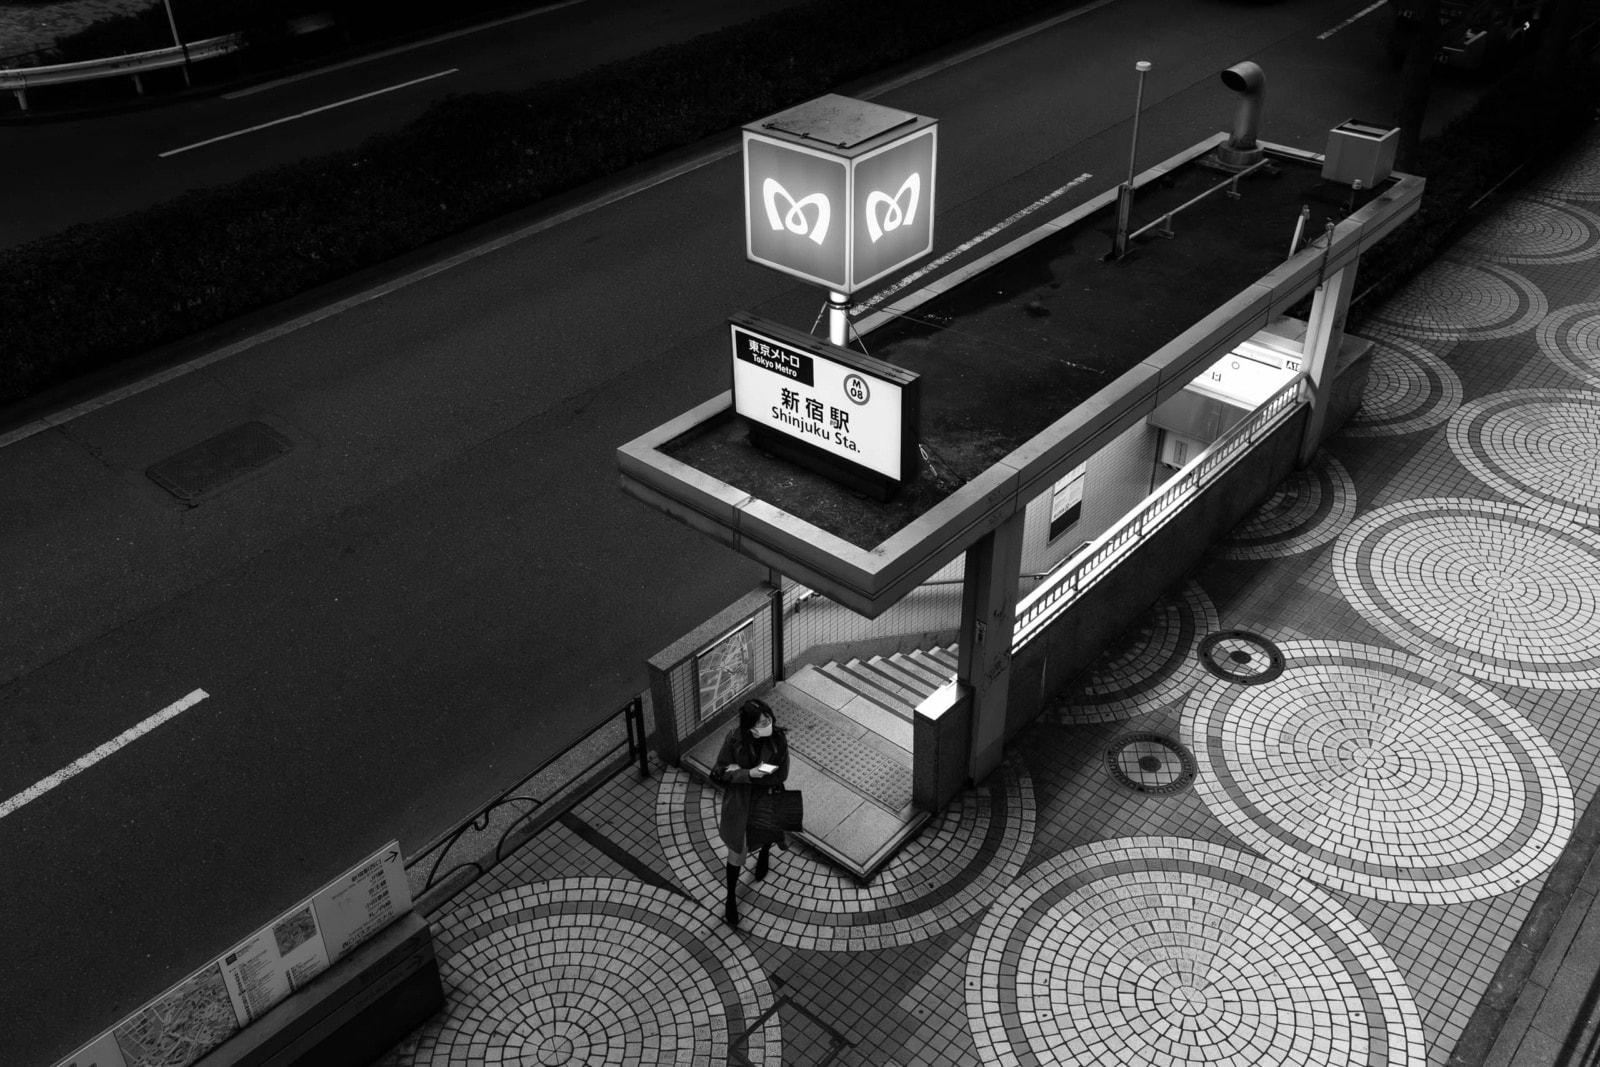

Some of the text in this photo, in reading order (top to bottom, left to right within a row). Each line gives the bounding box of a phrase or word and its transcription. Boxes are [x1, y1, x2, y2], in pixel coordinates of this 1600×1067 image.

[748, 339, 800, 369] 東京メトロ
[752, 353, 797, 377] Tokyo Metro
[850, 387, 863, 400] 08
[852, 379, 861, 389] M
[781, 387, 849, 433] 新宿駅
[771, 406, 861, 453] Shinjuku Sta.
